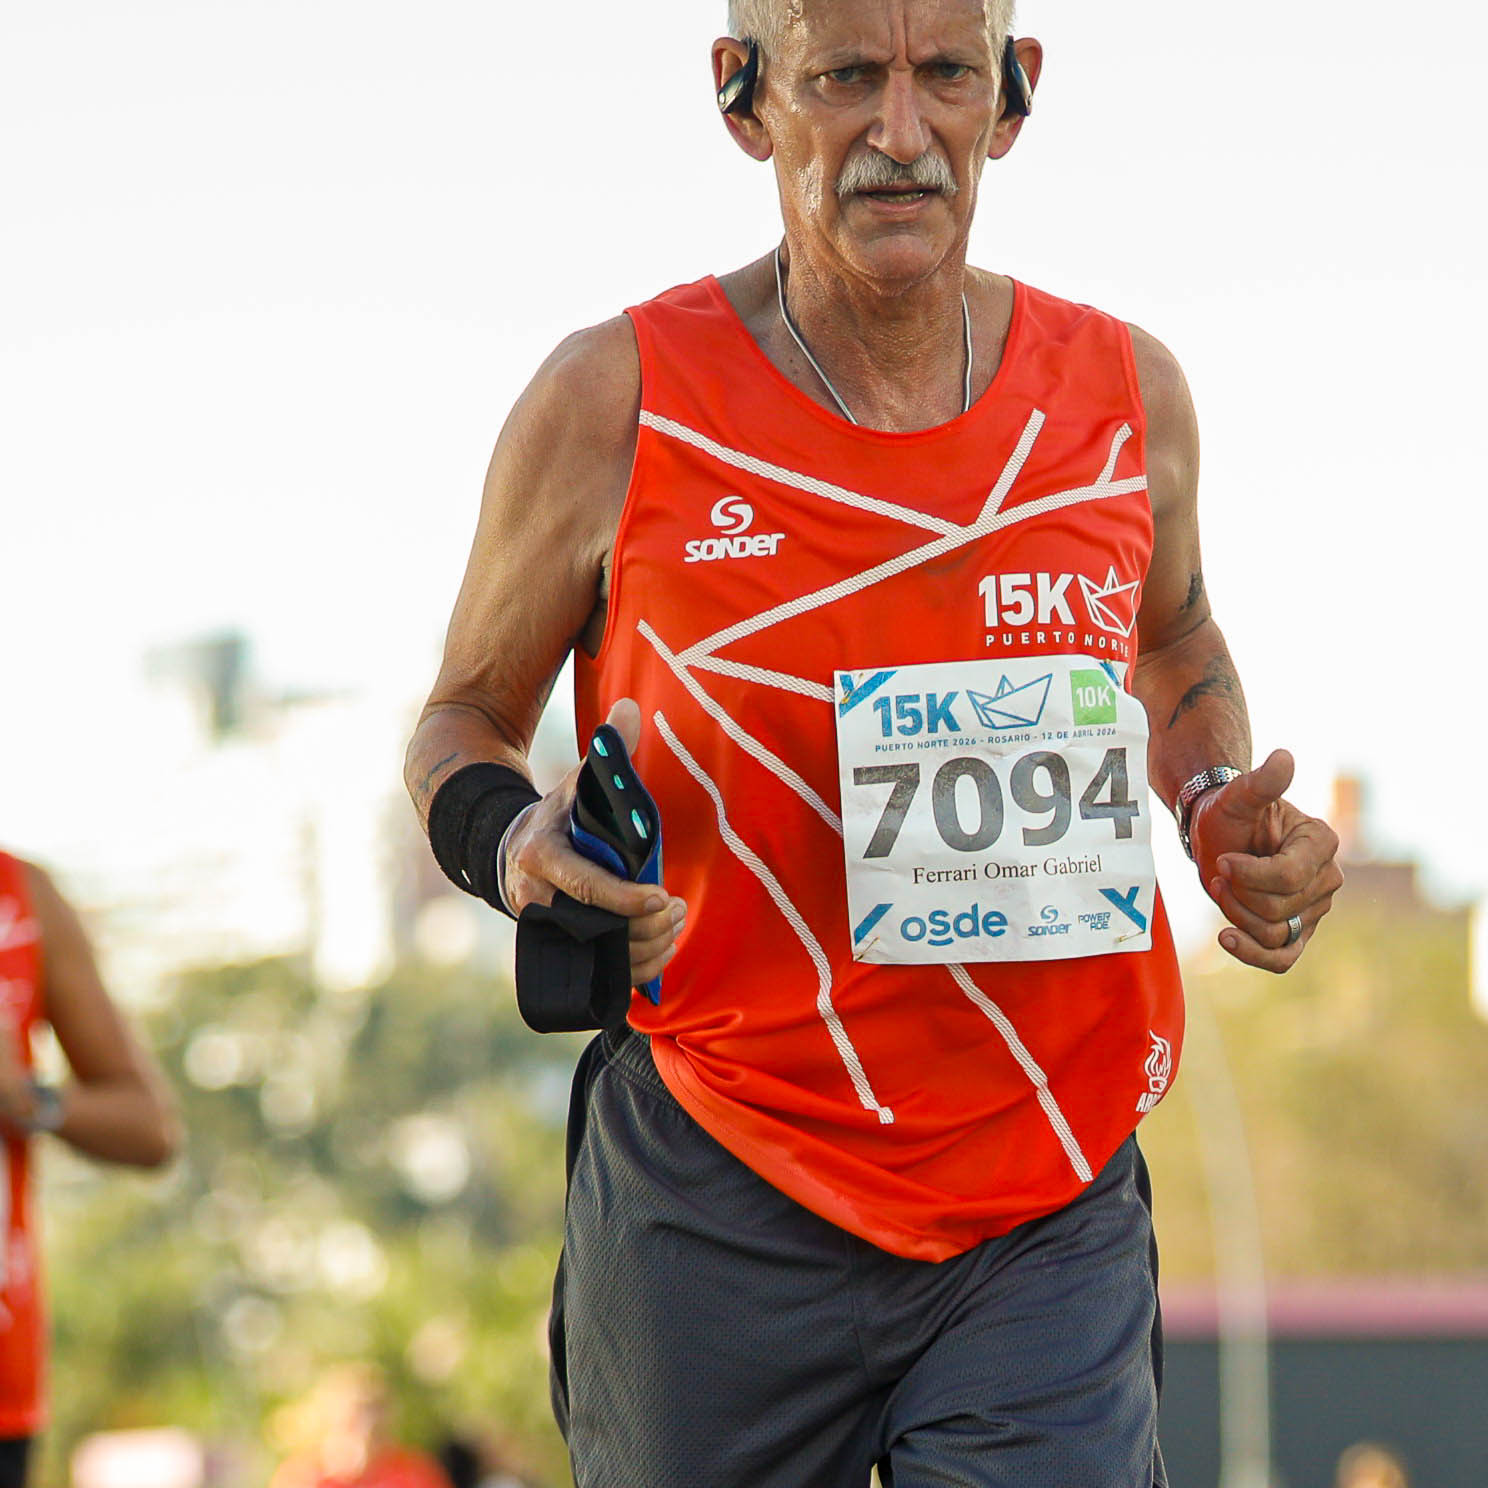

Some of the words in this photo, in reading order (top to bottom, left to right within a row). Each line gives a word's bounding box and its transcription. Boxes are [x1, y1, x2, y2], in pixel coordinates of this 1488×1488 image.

[978, 572, 1076, 627] 15K
[985, 631, 1075, 647] PUERTO
[1084, 633, 1129, 658] NORTE
[1075, 684, 1113, 709] 10K
[872, 690, 962, 738] 15K
[875, 742, 914, 752] PUERTO
[917, 739, 949, 749] NORTE
[952, 737, 977, 746] 2026
[987, 733, 1031, 744] ROSARIO
[1041, 731, 1053, 740] 12
[1056, 730, 1069, 739] DE
[853, 747, 1140, 860] 7094
[912, 862, 978, 884] Ferrari
[984, 861, 1037, 880] Omar
[1043, 854, 1103, 876] Gabriel
[900, 902, 1009, 940] osde
[1077, 911, 1111, 924] POWER
